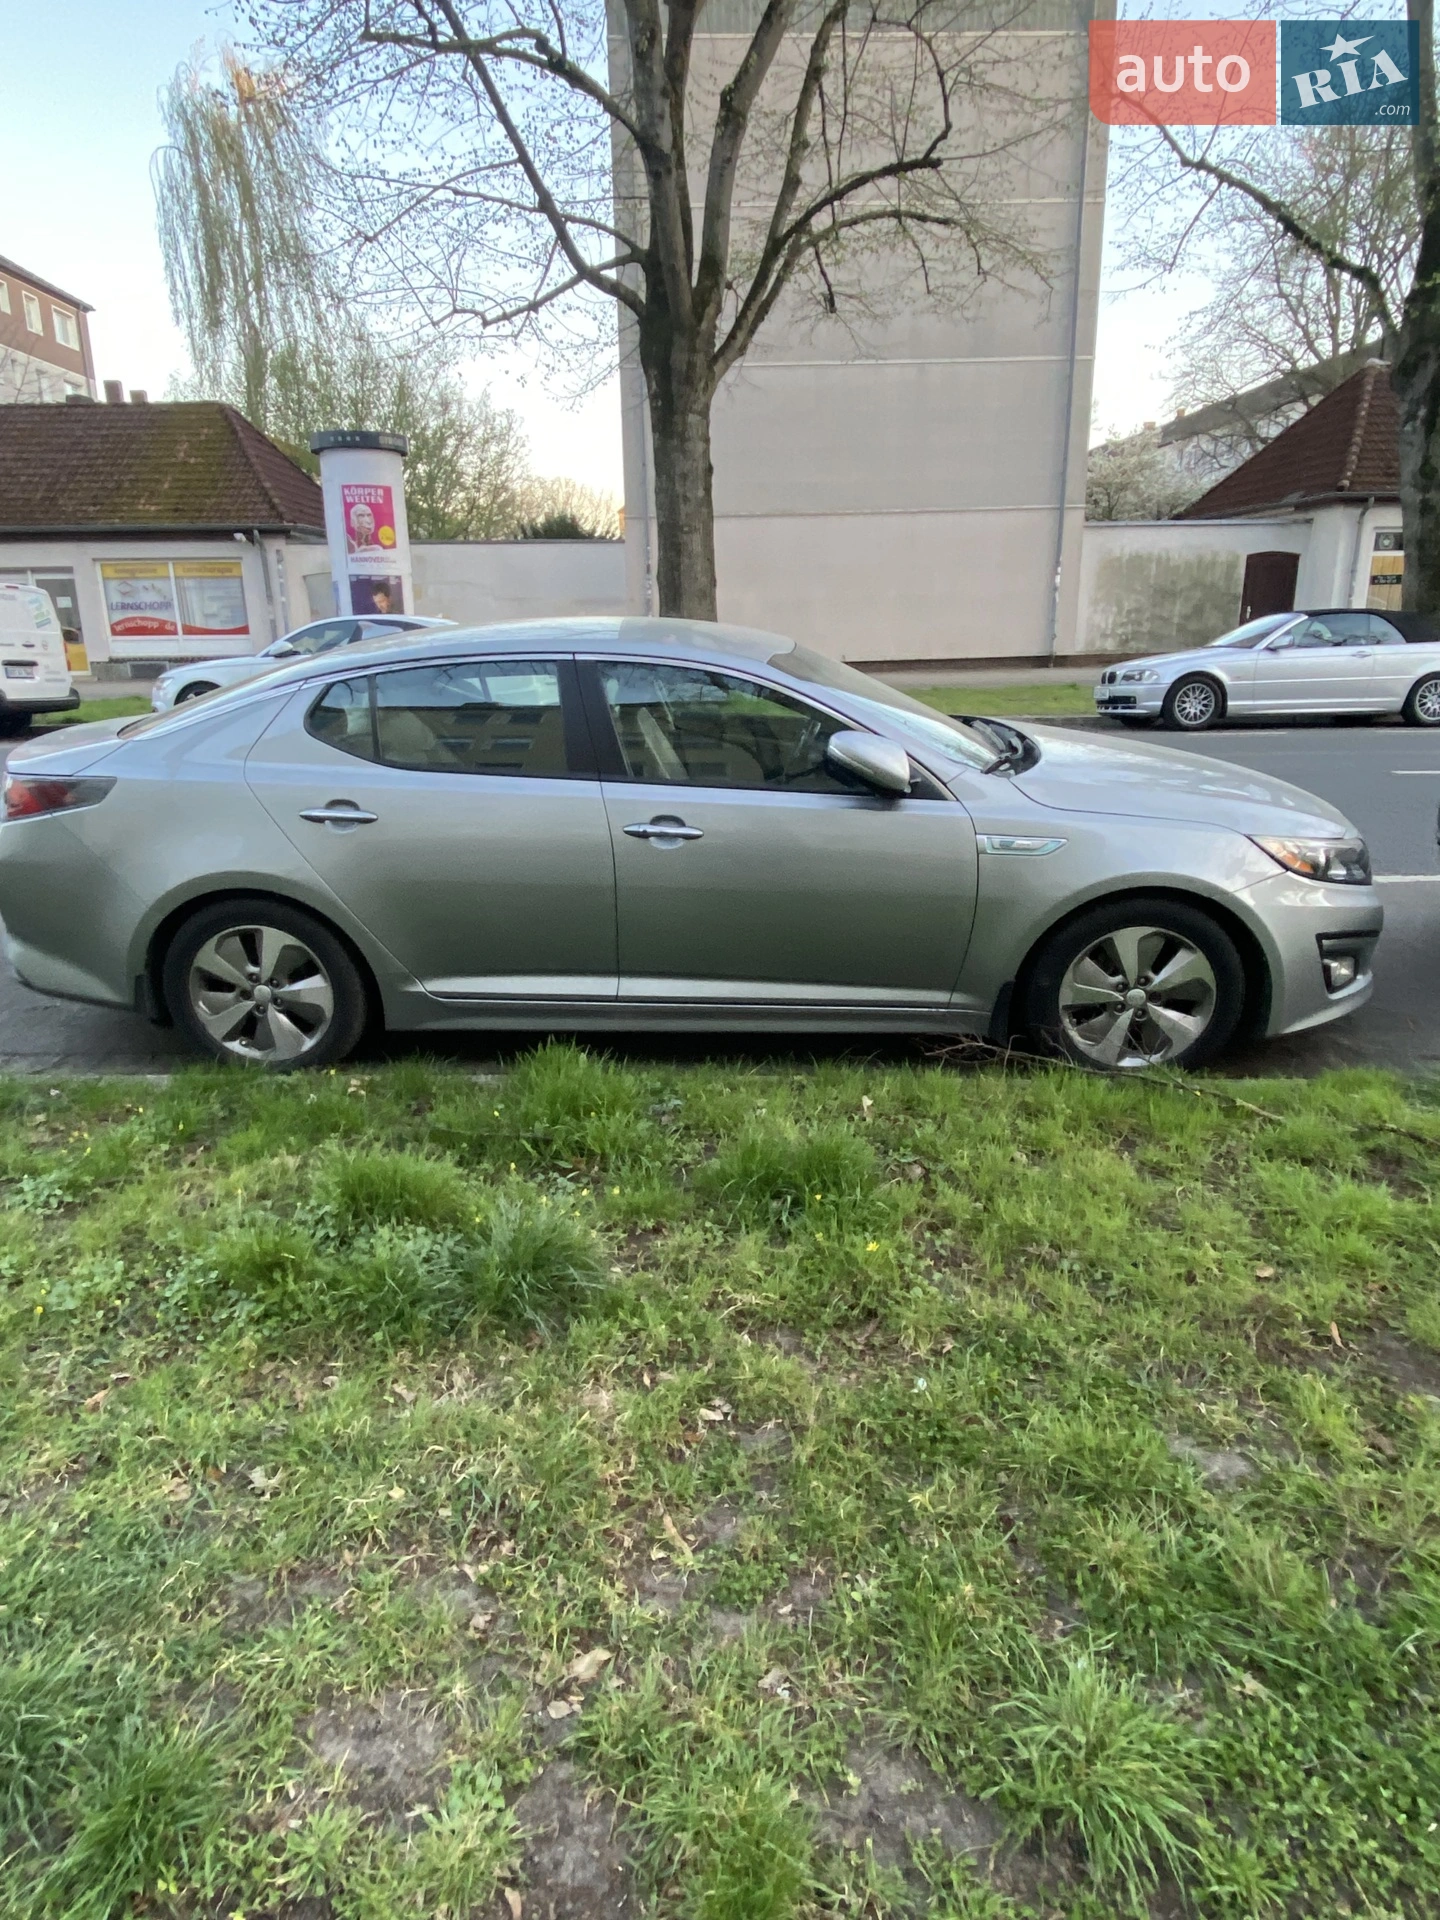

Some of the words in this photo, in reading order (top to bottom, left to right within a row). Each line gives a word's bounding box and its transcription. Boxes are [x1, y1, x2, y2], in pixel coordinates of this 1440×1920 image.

[344, 486, 384, 496] KÖRPER
[345, 495, 384, 504] WELTEN
[110, 601, 172, 611] LERNSCHOPP
